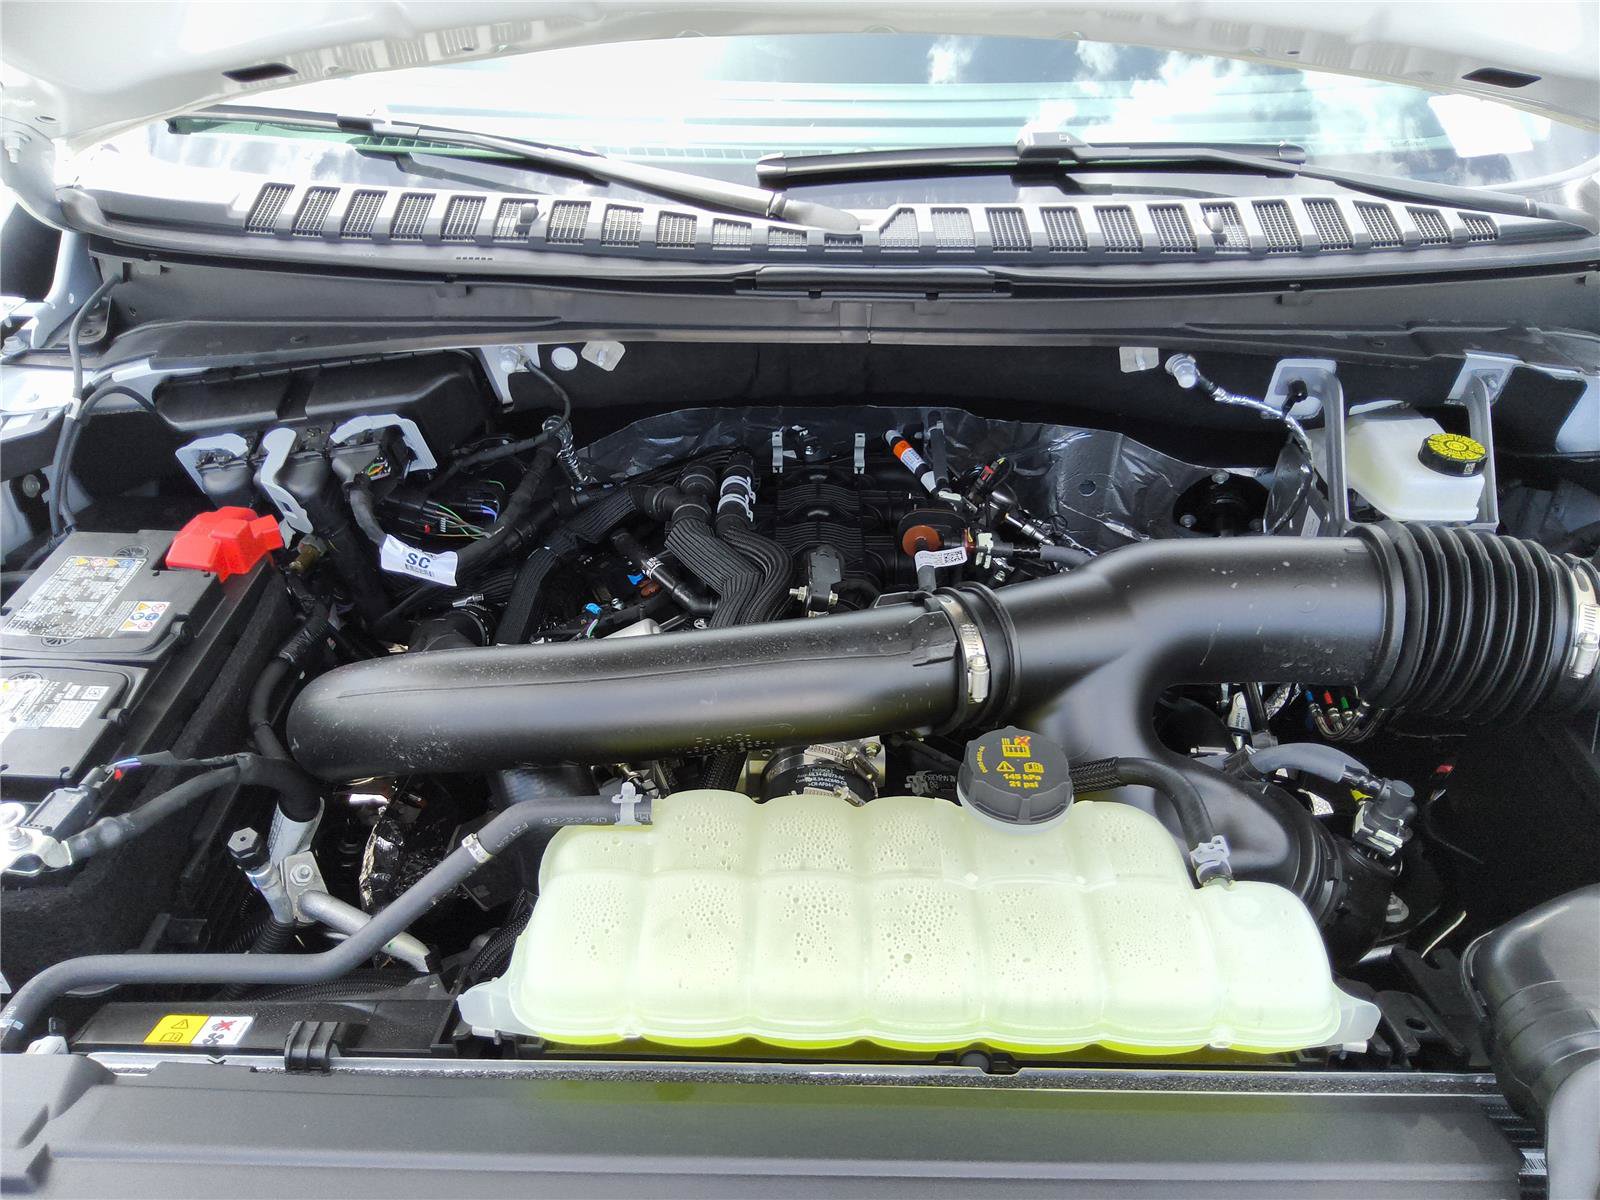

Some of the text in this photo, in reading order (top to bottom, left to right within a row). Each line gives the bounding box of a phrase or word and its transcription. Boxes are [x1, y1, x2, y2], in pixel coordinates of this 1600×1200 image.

[405, 552, 431, 569] SC
[1008, 780, 1039, 789] 21 psi
